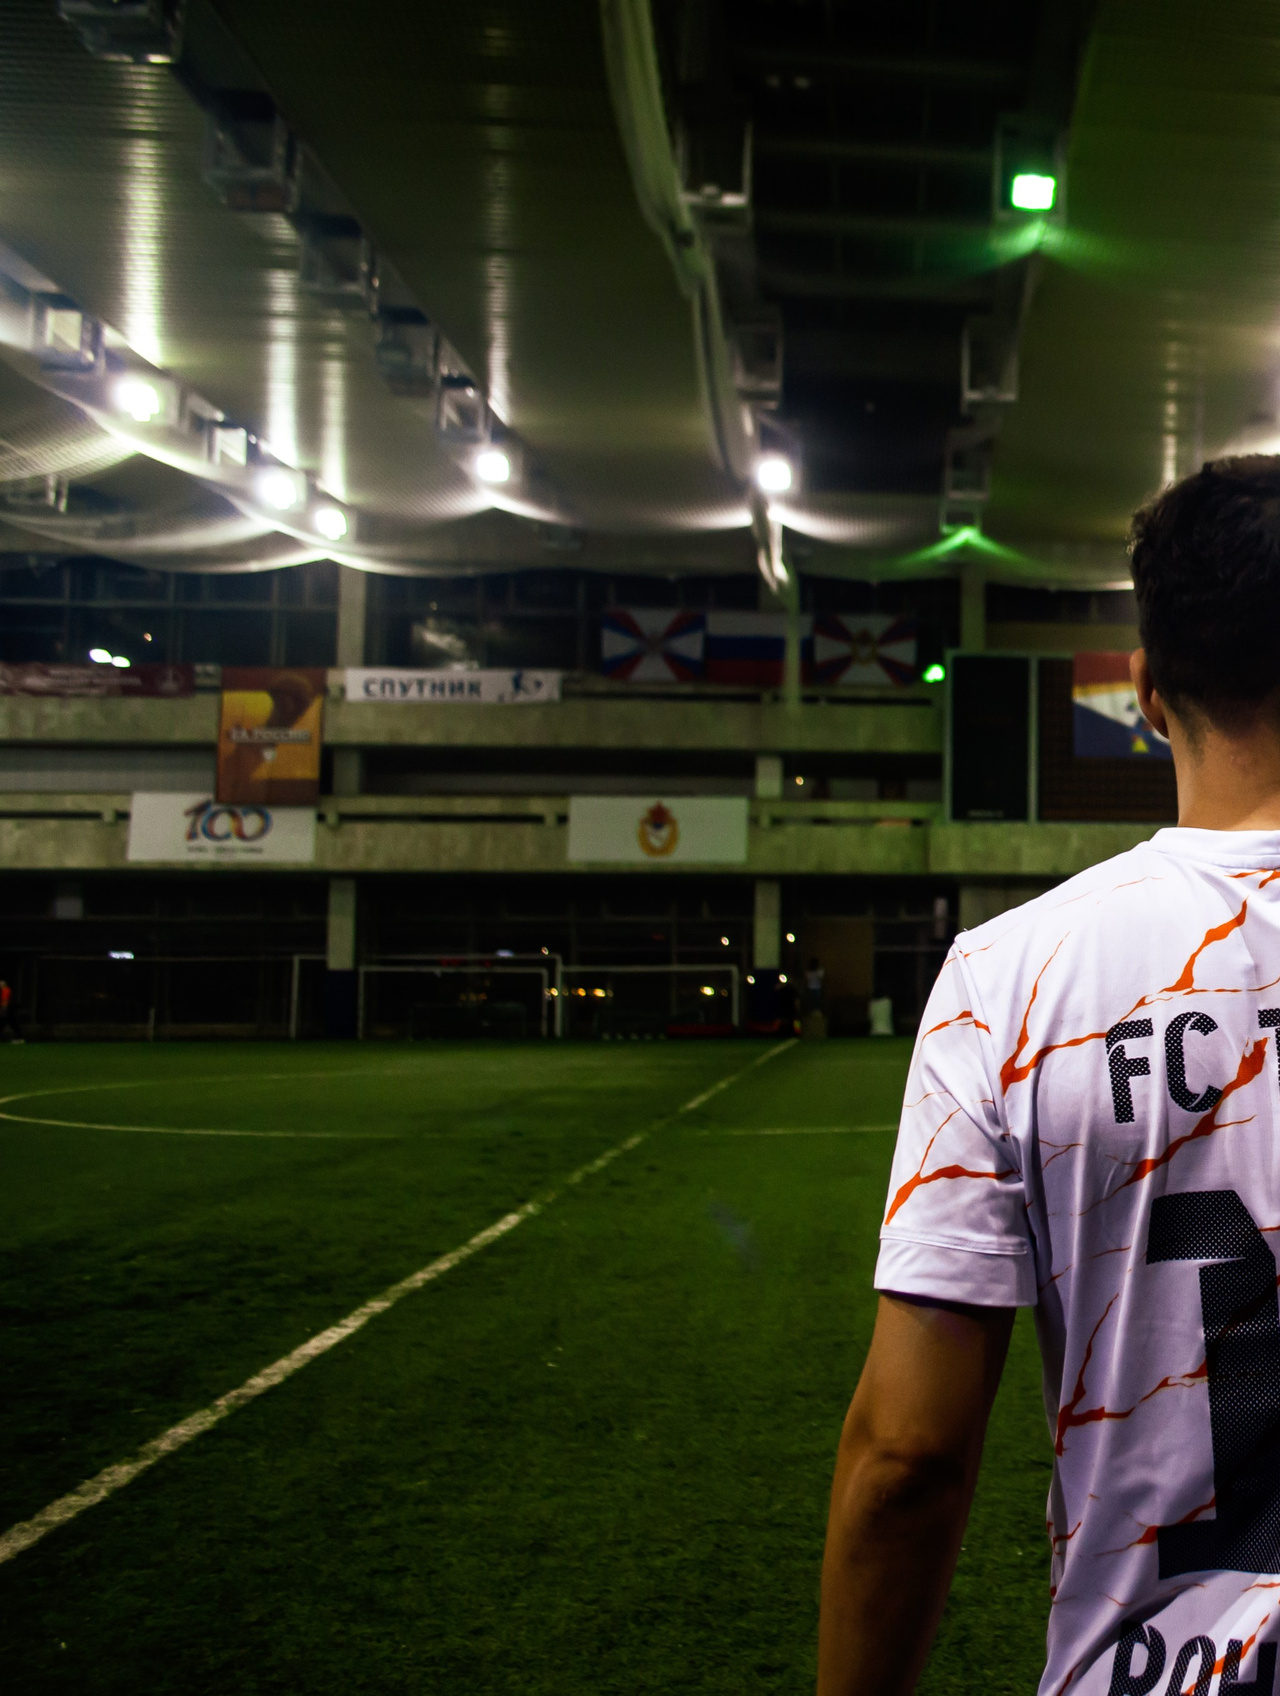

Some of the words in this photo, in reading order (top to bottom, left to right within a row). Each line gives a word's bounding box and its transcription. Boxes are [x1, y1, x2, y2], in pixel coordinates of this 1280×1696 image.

[362, 677, 482, 697] СПУТНИК
[184, 800, 273, 842] 100
[1105, 1011, 1224, 1124] FC
